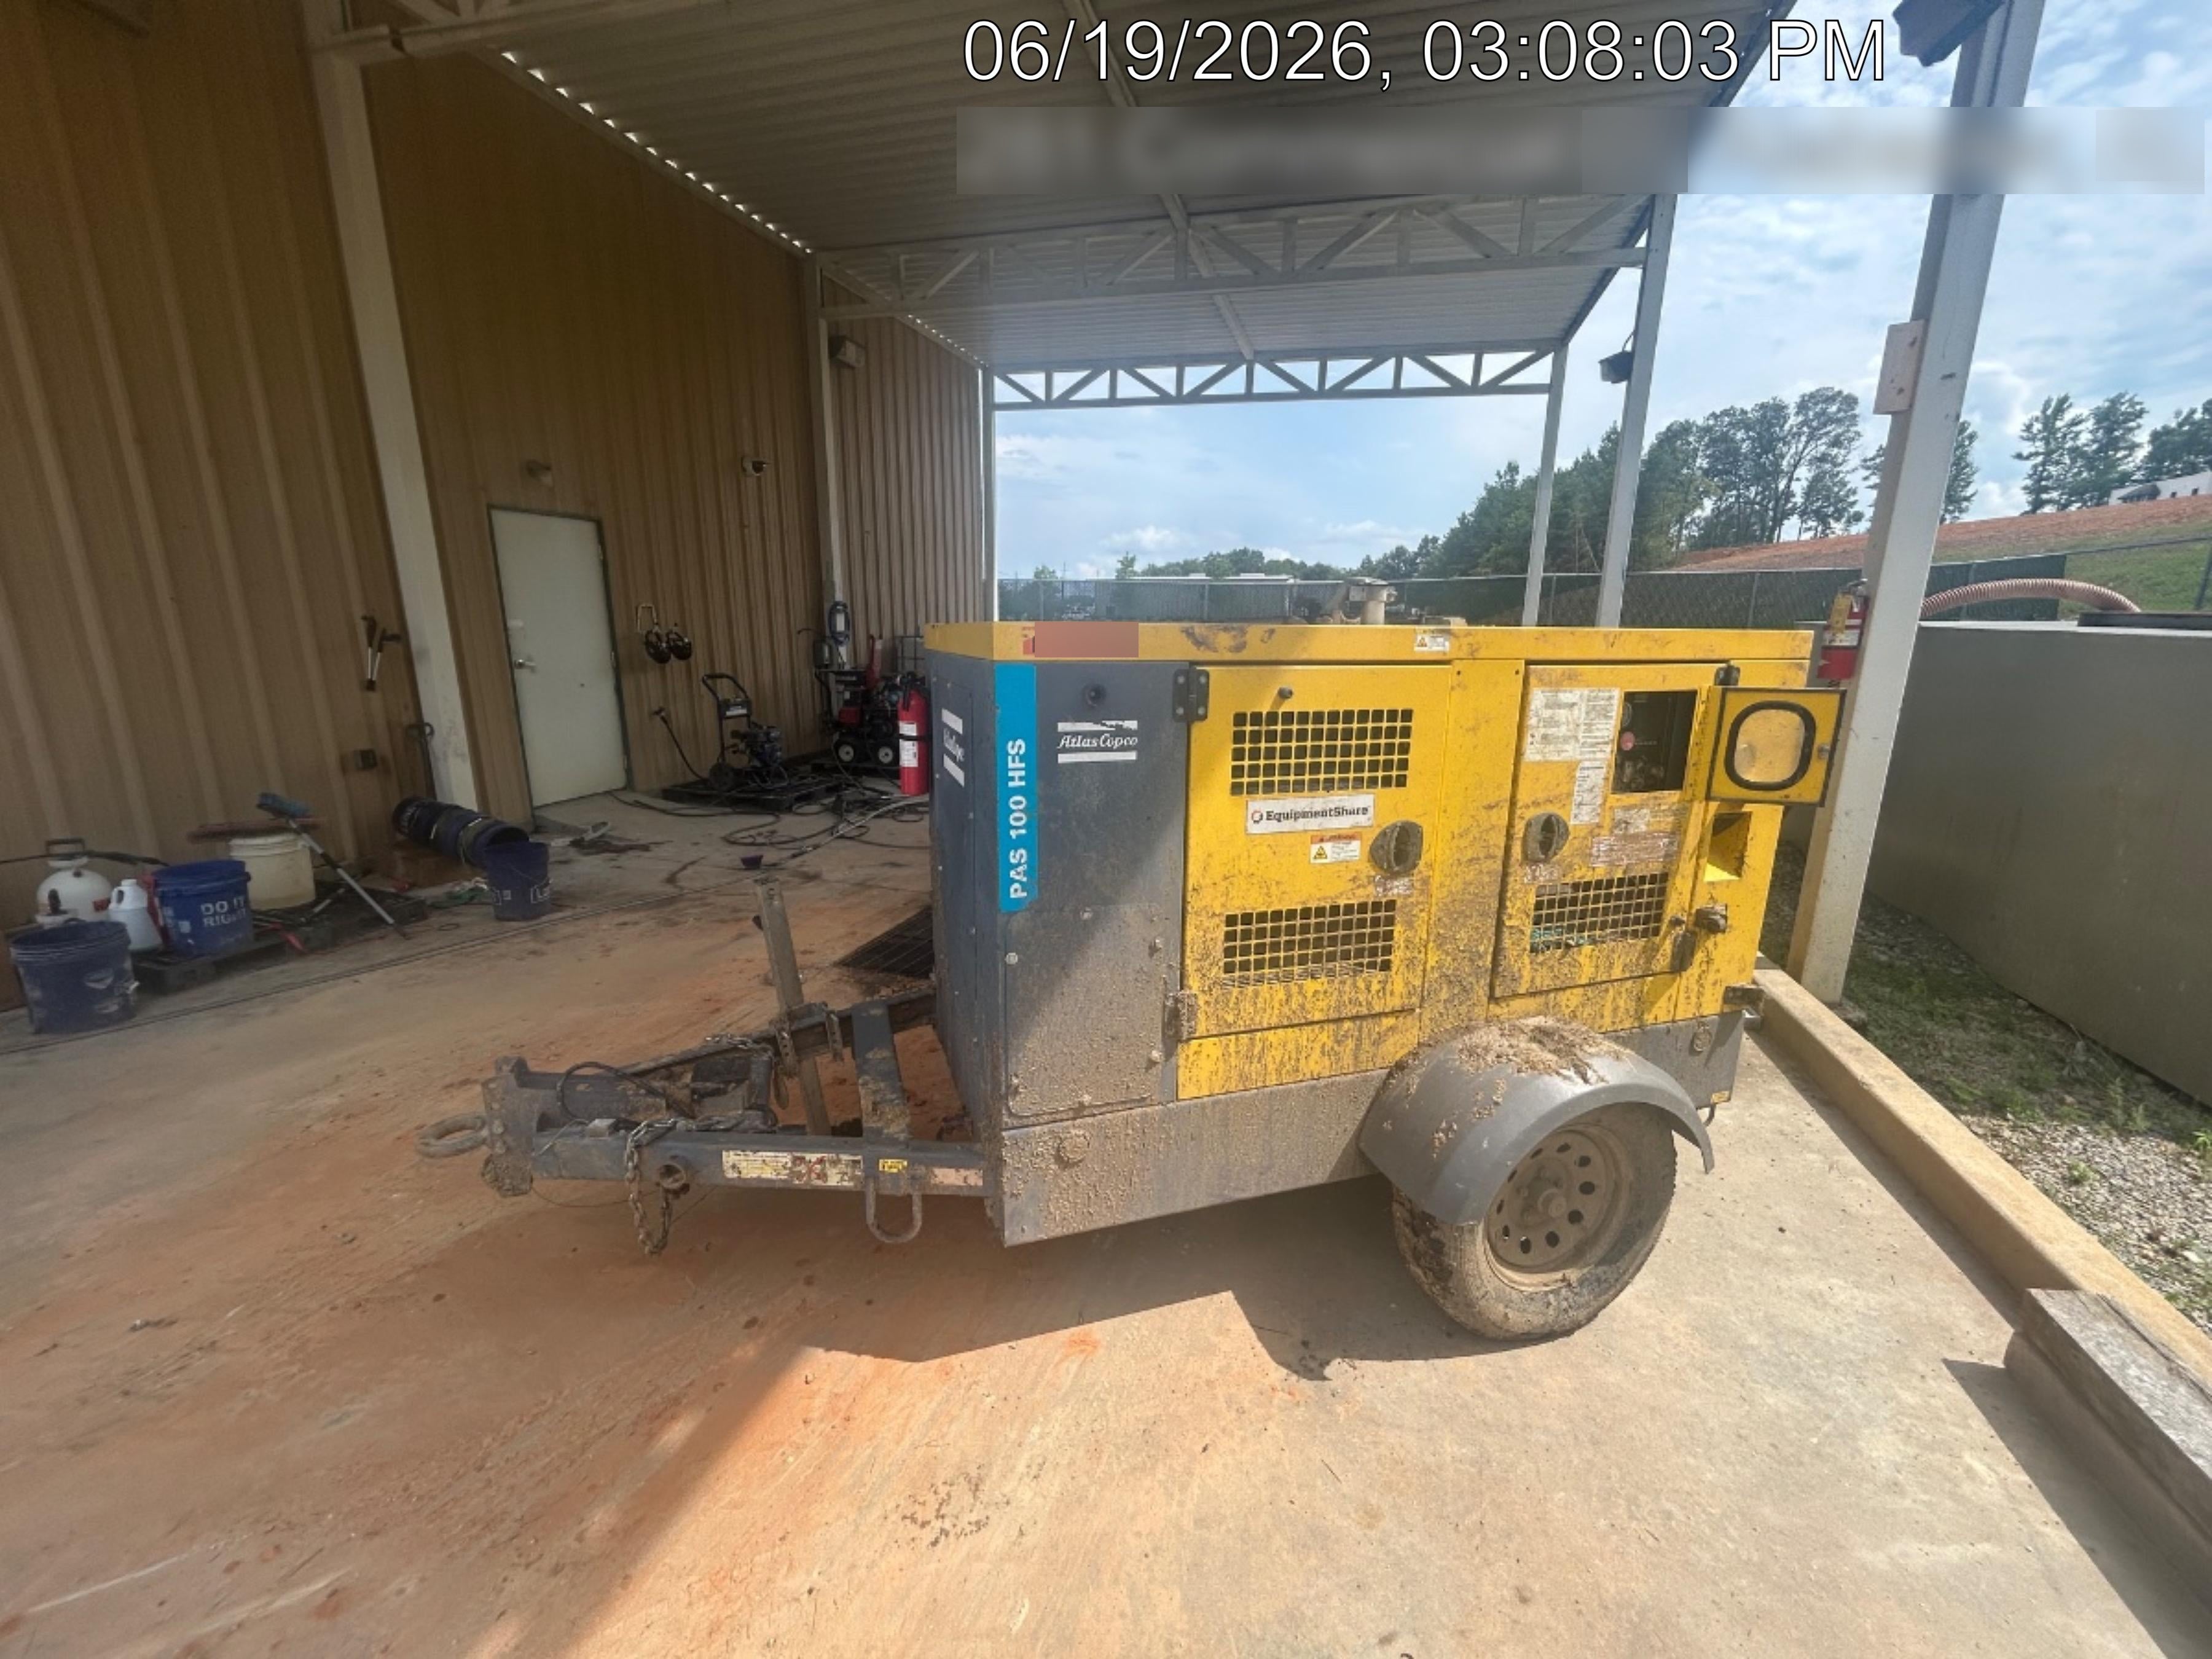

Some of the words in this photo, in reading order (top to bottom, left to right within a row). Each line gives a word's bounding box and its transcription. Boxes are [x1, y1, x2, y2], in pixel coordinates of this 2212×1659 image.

[1056, 735, 1099, 748] Atlas
[1100, 733, 1138, 750] Copco
[1007, 739, 1026, 788] HFS
[1008, 795, 1027, 840] 100
[1265, 806, 1368, 823] EquipmentShare
[1009, 848, 1027, 899] PAS
[200, 900, 229, 916] DO
